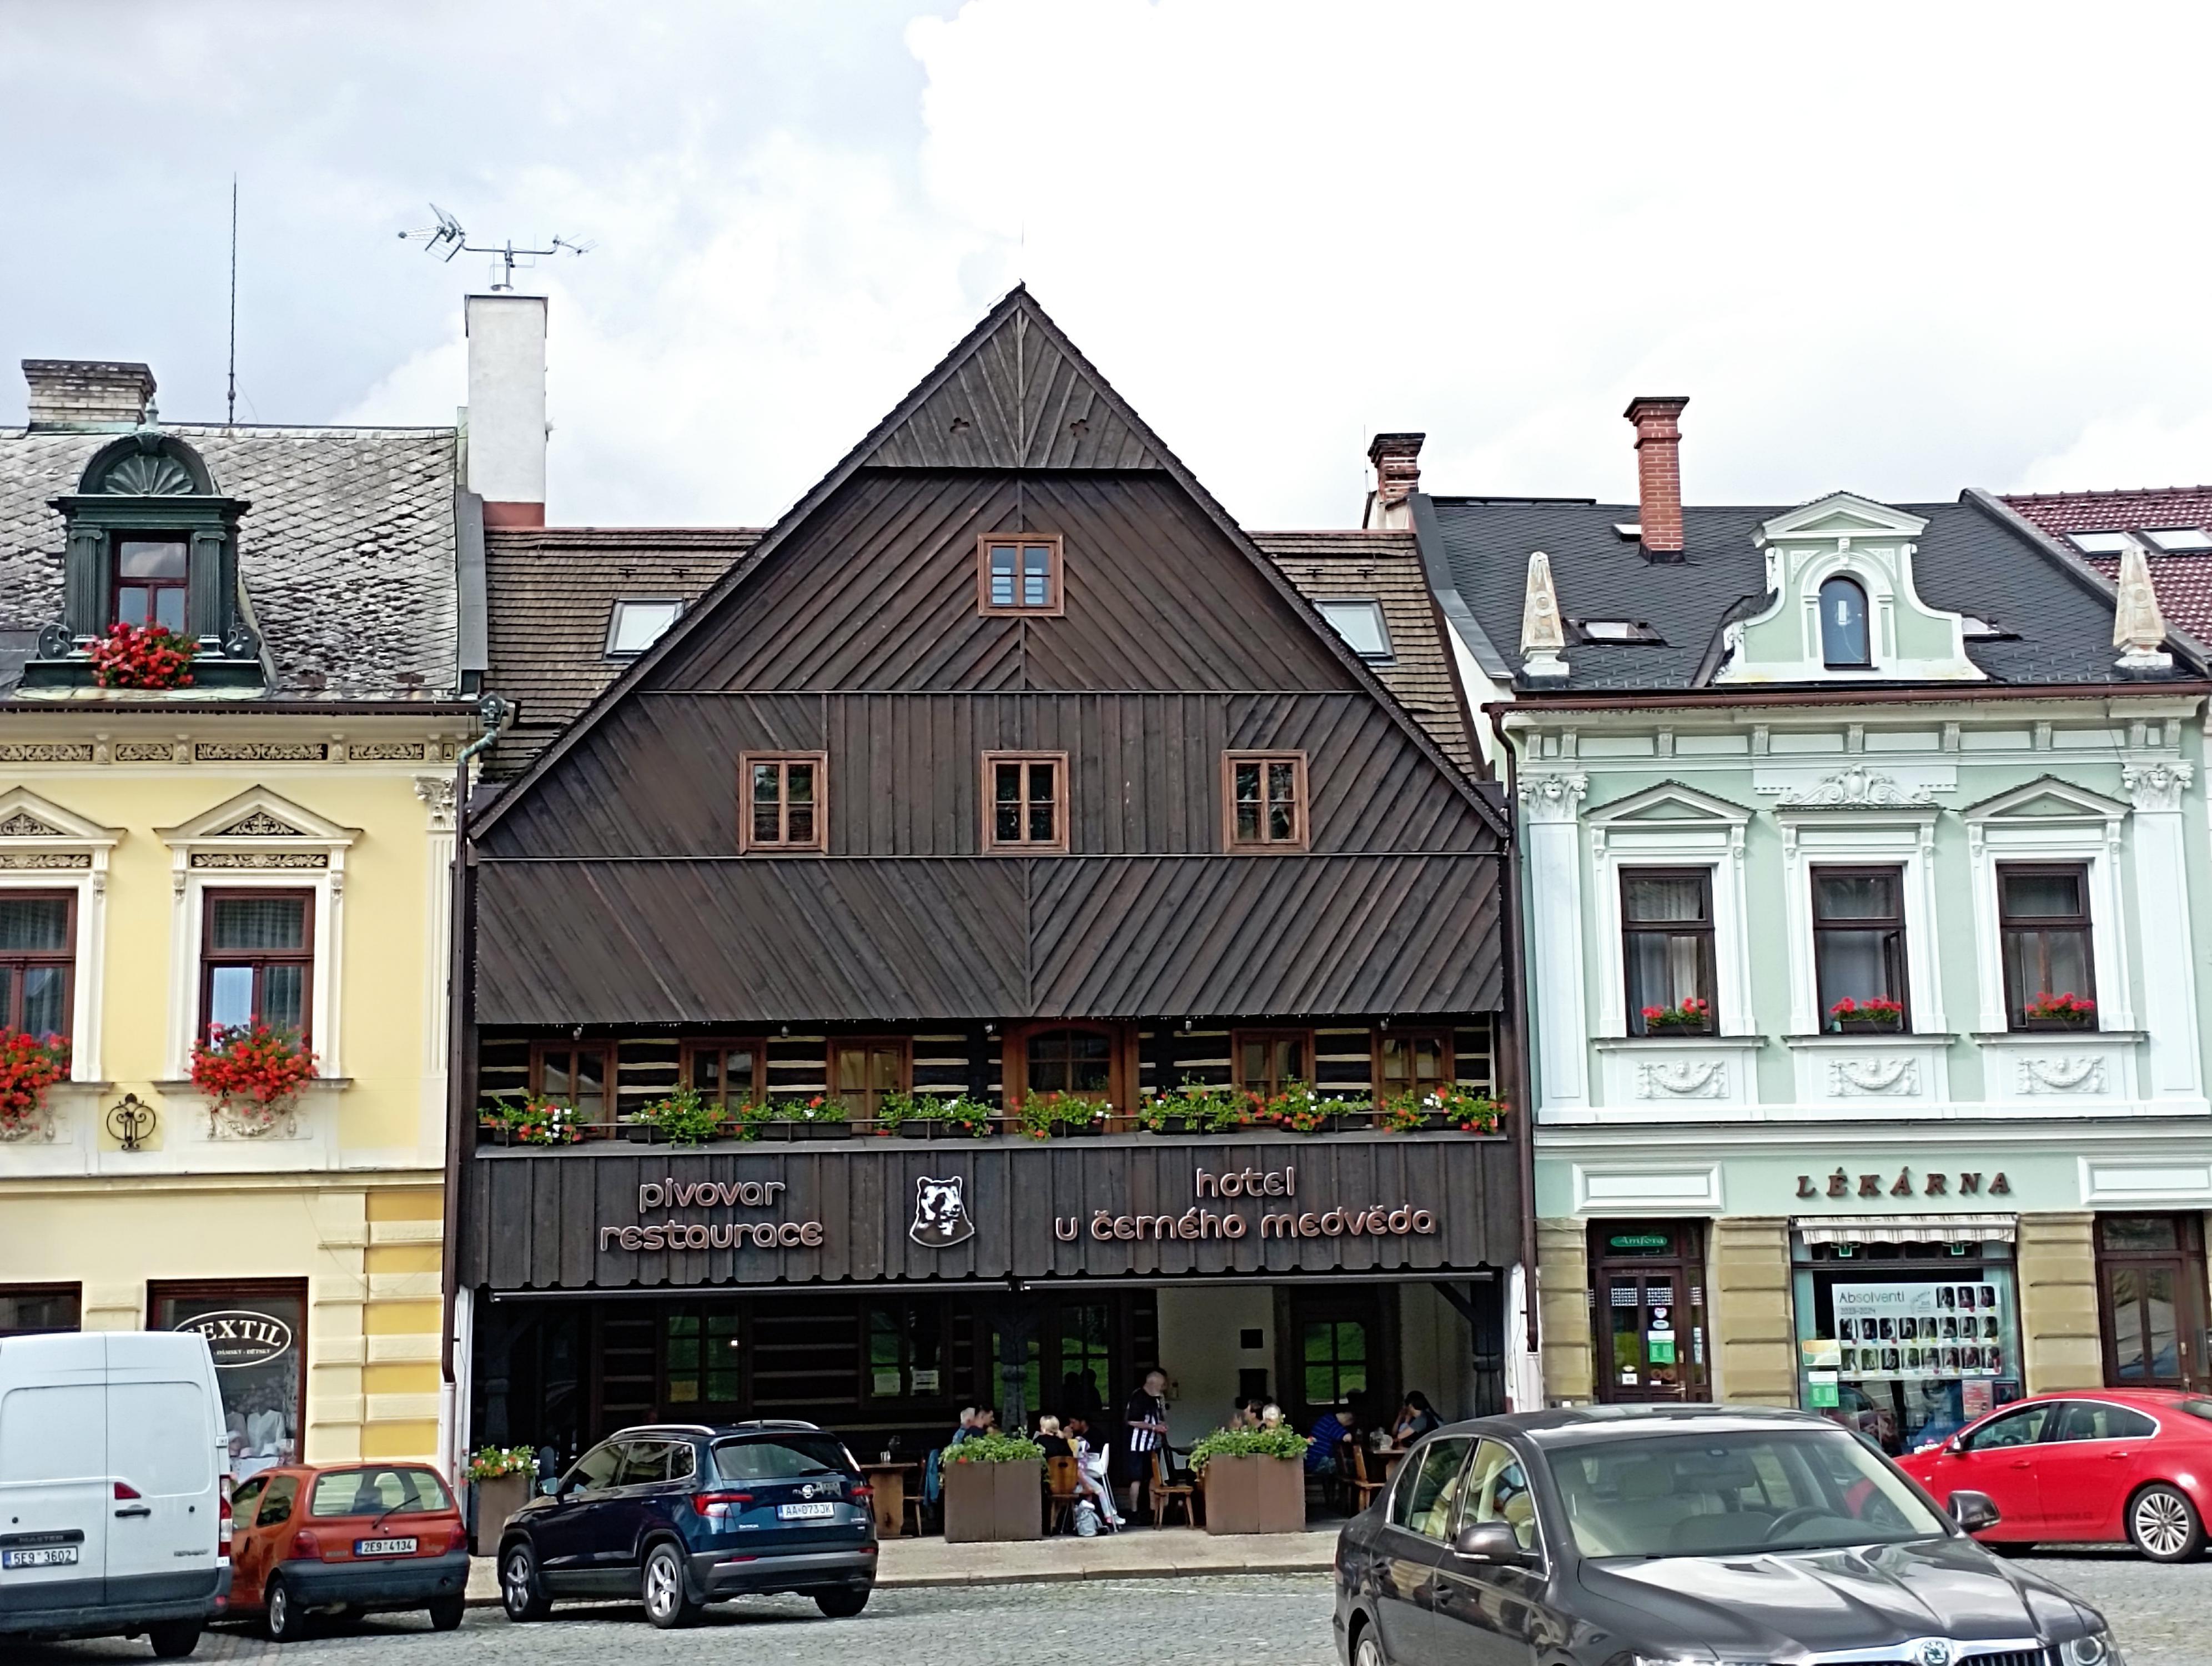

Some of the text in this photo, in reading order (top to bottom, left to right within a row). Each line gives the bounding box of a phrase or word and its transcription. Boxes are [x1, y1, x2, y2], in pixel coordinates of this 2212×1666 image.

[640, 1178, 785, 1213] pivovar
[1197, 1166, 1295, 1198] hotel
[1796, 1166, 2010, 1197] LÉKÁRNA
[600, 1220, 823, 1251] restaurace
[1055, 1204, 1436, 1241] u černého medvěda
[1620, 1236, 1664, 1246] Amfora
[184, 1319, 281, 1346] EXTIL
[14, 1550, 71, 1564] 5E9 3602
[364, 1542, 382, 1552] 2E9
[389, 1540, 412, 1550] 4134
